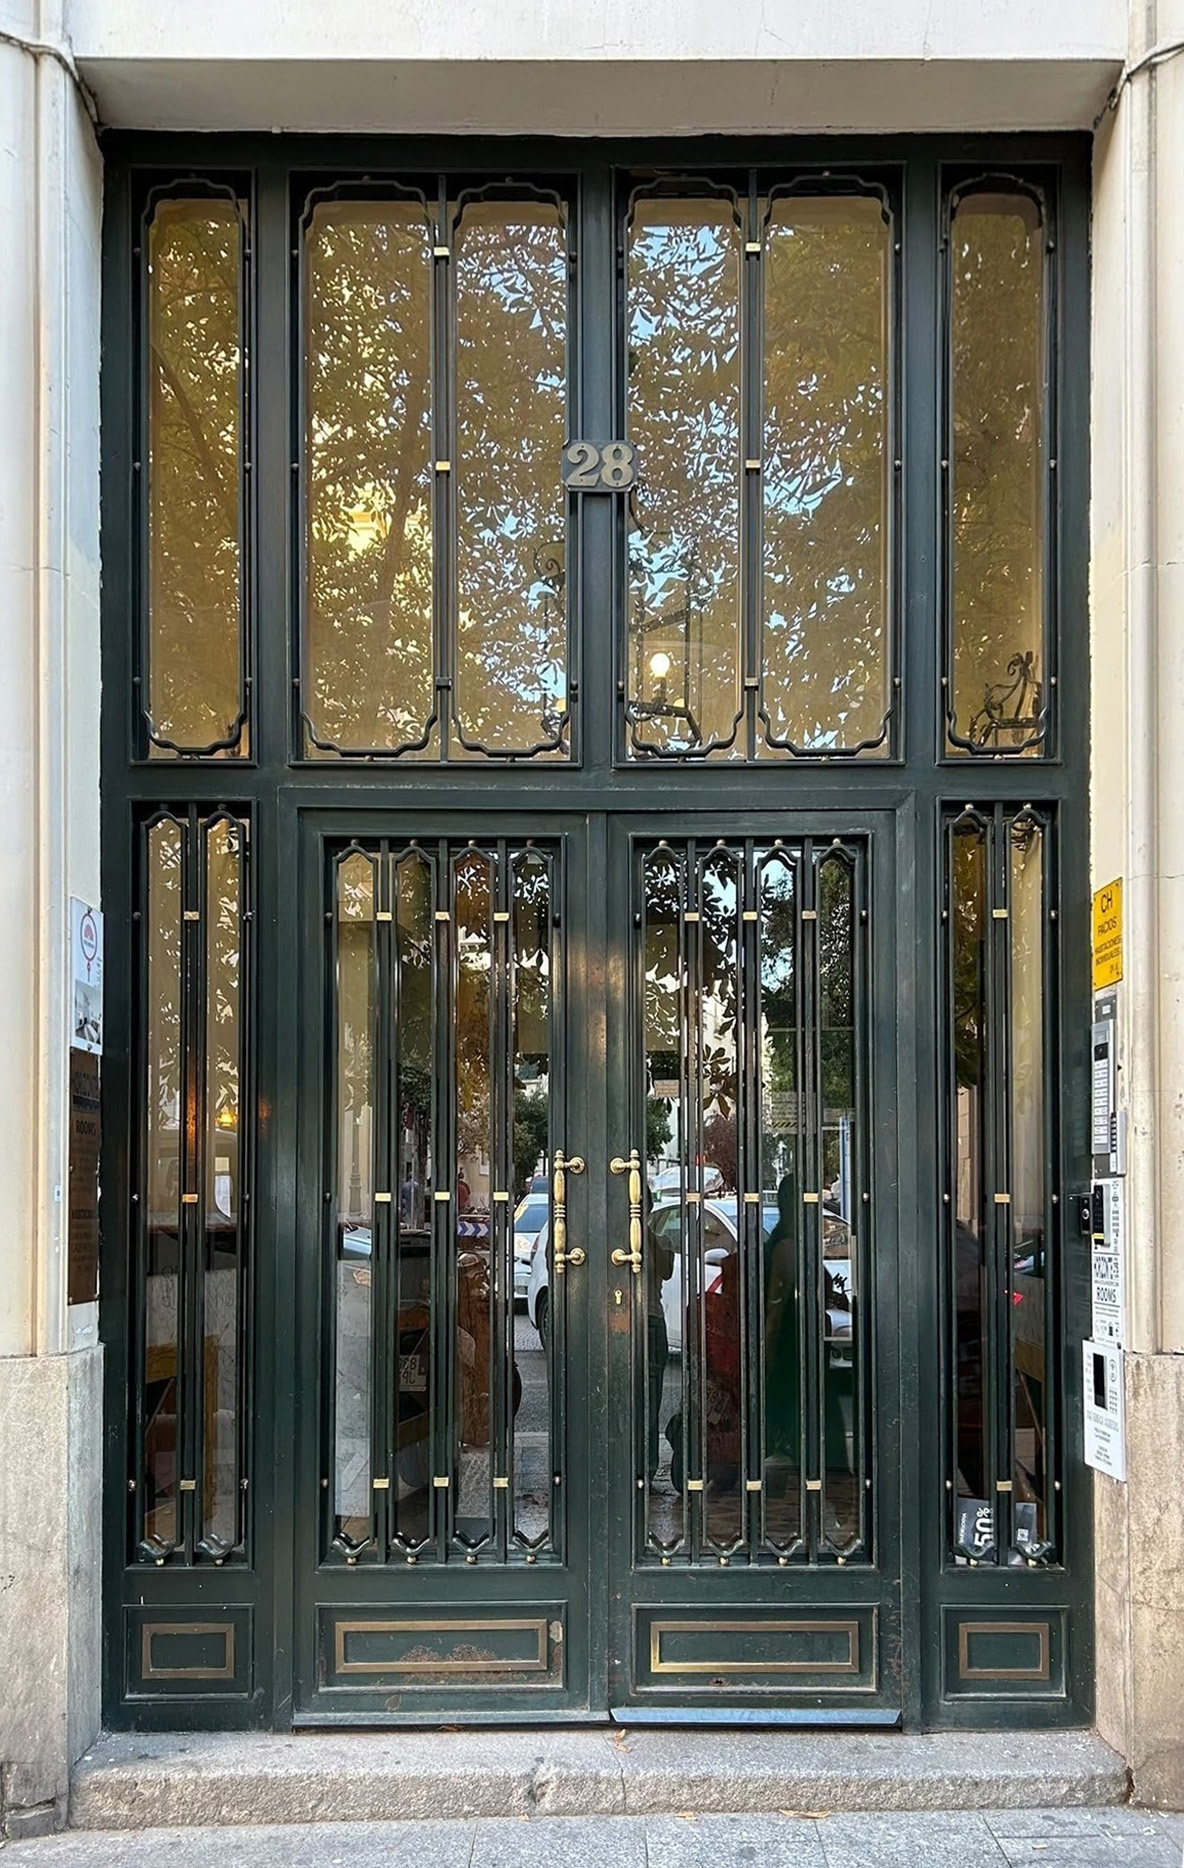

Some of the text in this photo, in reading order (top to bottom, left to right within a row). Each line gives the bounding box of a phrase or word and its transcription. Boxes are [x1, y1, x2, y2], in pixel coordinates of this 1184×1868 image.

[567, 443, 634, 487] 28
[1100, 890, 1113, 914] CH
[1096, 1286, 1117, 1304] ROOMS
[974, 1507, 993, 1547] 50%
